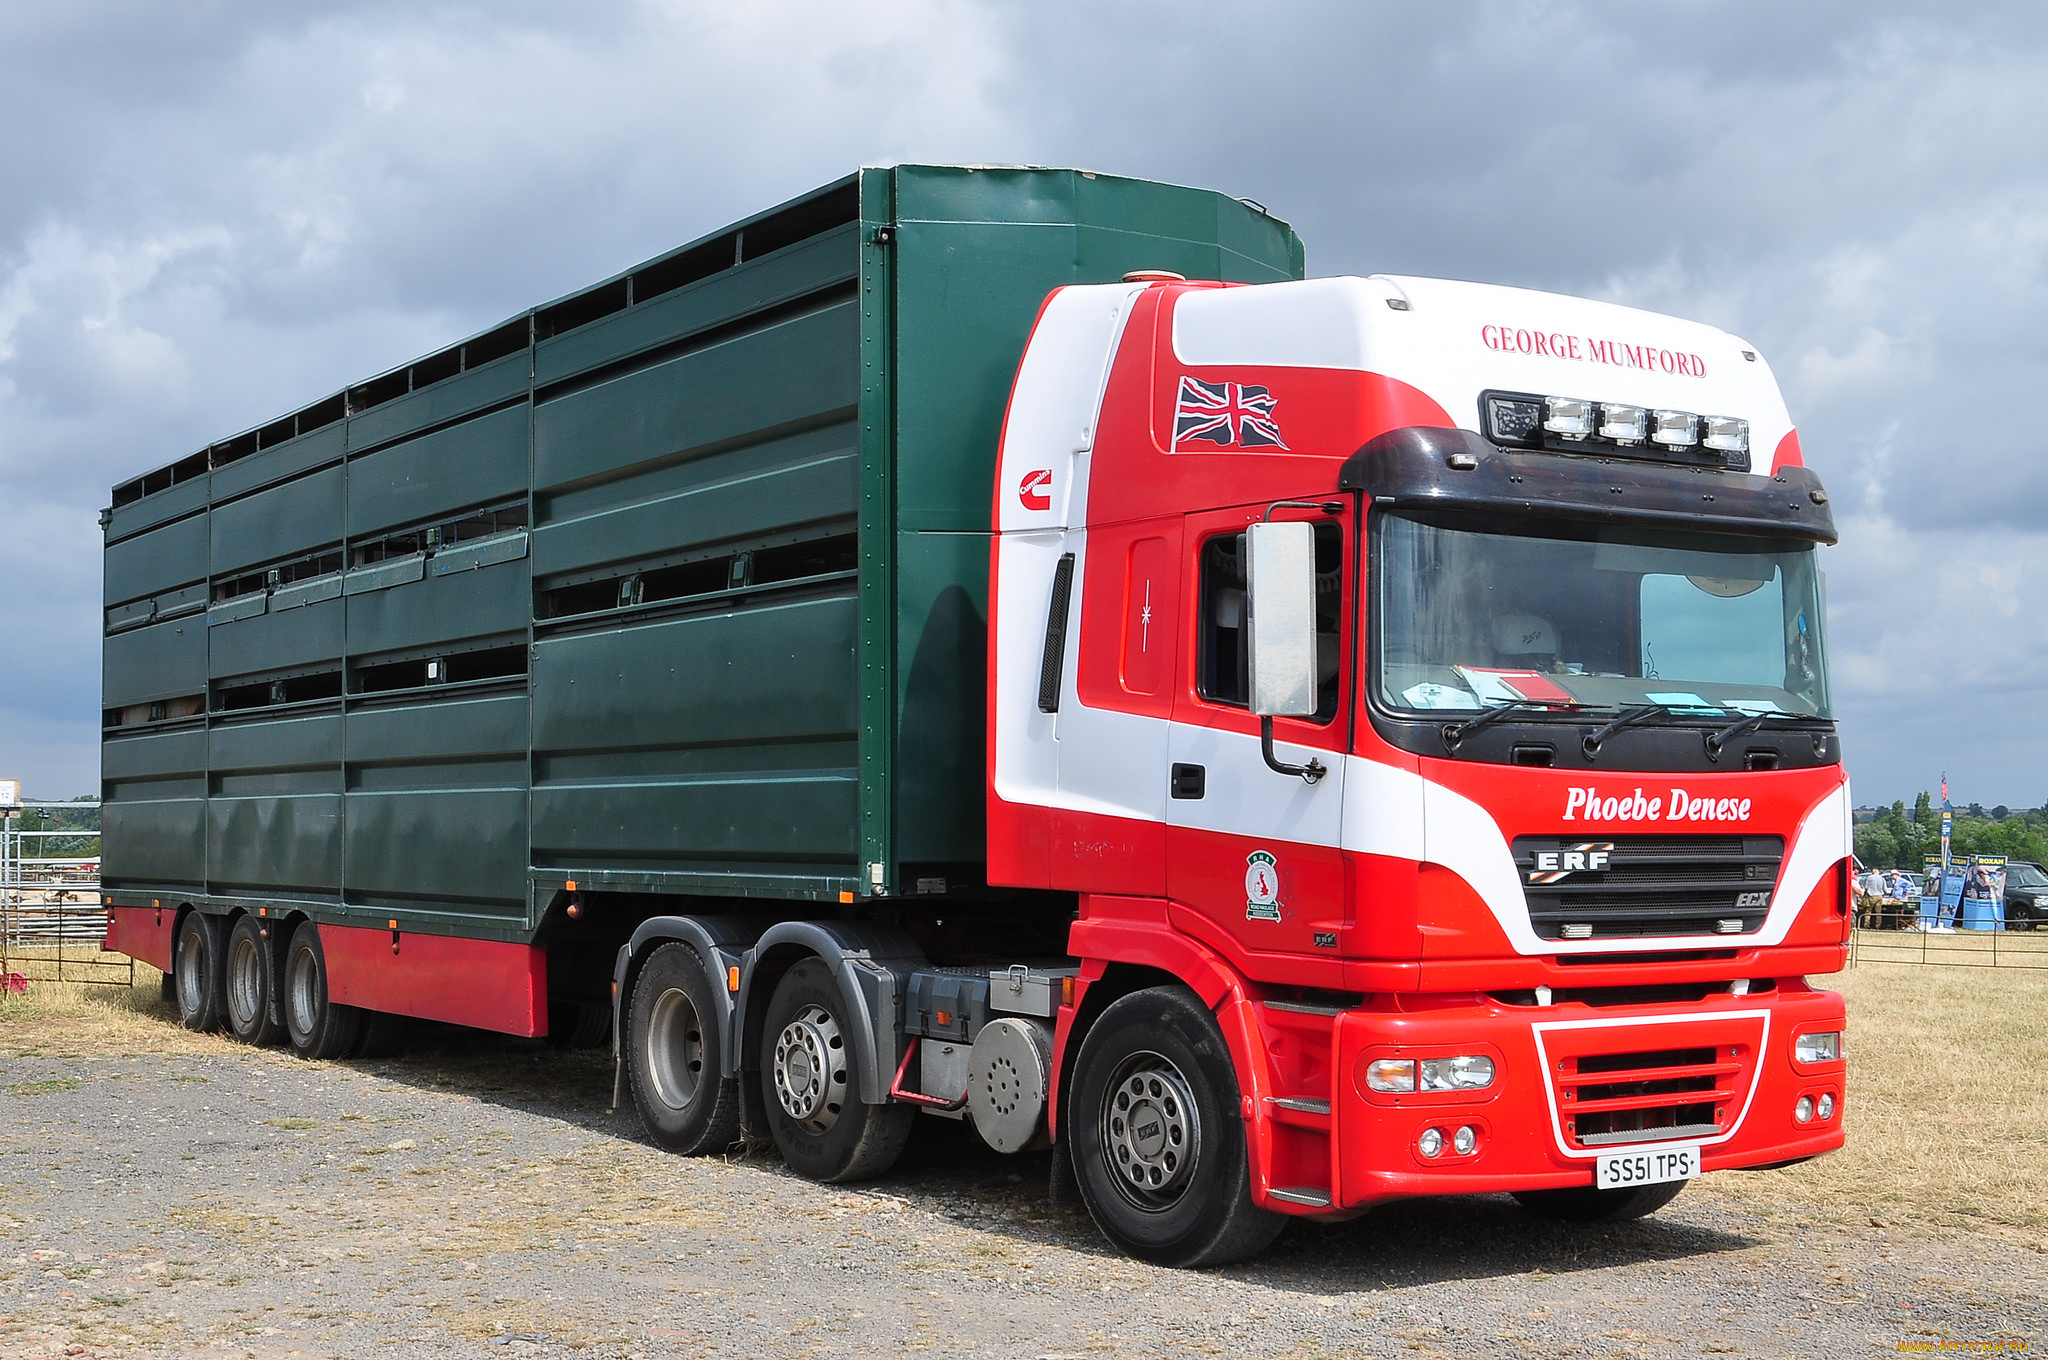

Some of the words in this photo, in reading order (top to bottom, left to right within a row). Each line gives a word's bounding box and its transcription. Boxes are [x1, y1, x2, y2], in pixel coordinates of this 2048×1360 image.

[1482, 325, 1583, 360] GEORGE
[1587, 338, 1706, 378] MUMFORD
[1019, 469, 1051, 495] Cummins
[1562, 787, 1662, 821] Phoebe
[1666, 788, 1752, 821] Denese
[1538, 851, 1609, 871] ERF
[1736, 892, 1770, 907] ECX
[1609, 1156, 1651, 1183] SS51
[1656, 1152, 1689, 1178] TPS
